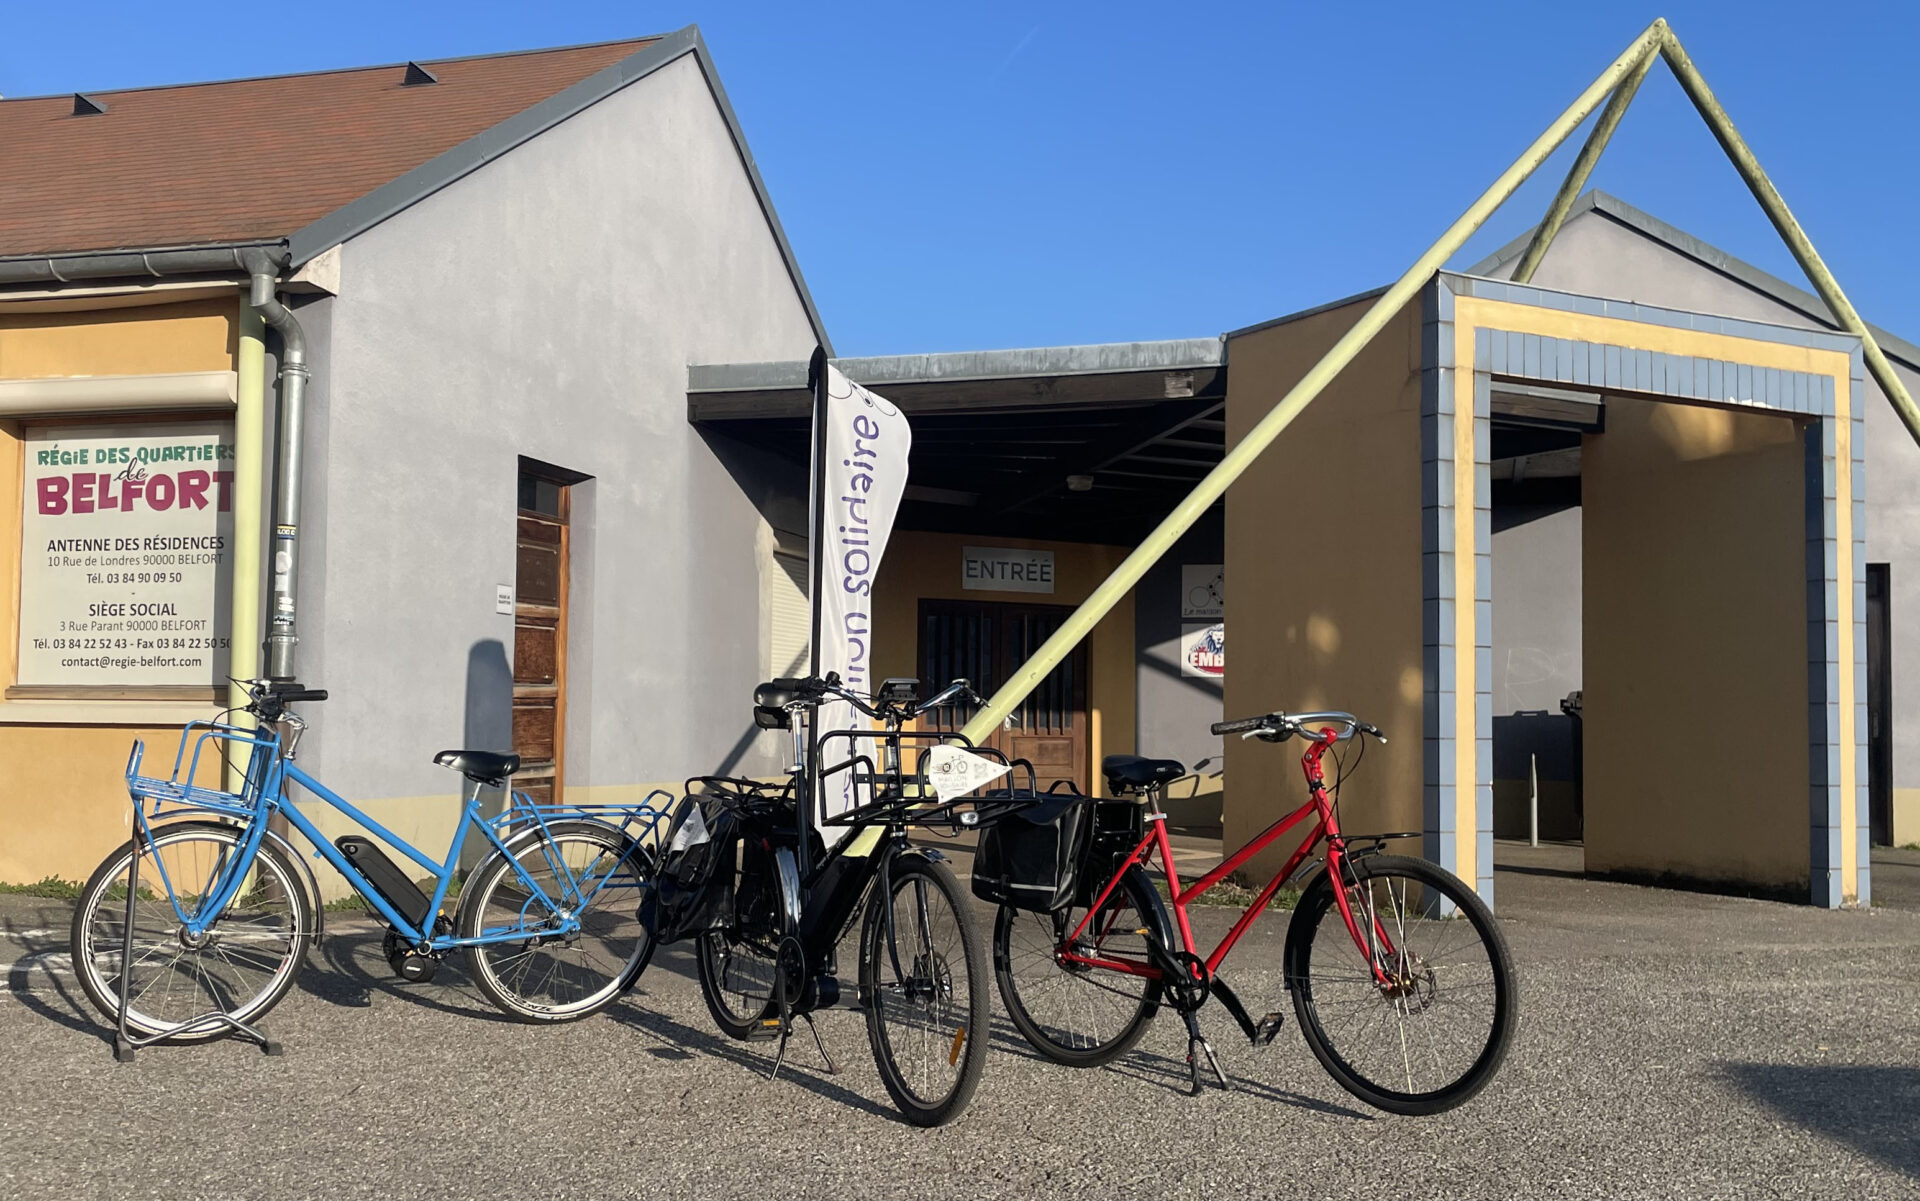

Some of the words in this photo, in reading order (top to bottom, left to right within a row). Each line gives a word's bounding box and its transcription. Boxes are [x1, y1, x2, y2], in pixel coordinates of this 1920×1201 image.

[96, 447, 130, 464] DES
[113, 457, 149, 482] de
[37, 470, 235, 516] BELFORT
[47, 538, 111, 552] ANTENNE
[115, 537, 140, 552] DES
[143, 534, 225, 551] RÉSIDENCES
[48, 556, 60, 567] 10
[63, 556, 82, 567] Rue
[85, 555, 97, 567] de
[100, 554, 140, 567] Londres
[143, 554, 175, 566] 90000
[178, 553, 224, 565] BELFORT
[87, 573, 104, 584] Tél.
[107, 573, 119, 584] 03
[122, 573, 135, 584] 84
[138, 573, 151, 583] 90
[153, 573, 166, 583] 09
[169, 572, 182, 583] 50
[89, 600, 126, 617] SIÈGE
[130, 603, 178, 617] SOCIAL
[60, 621, 66, 631] 3
[69, 620, 88, 631] Rue
[91, 620, 124, 631] Parant
[126, 620, 159, 631] 90000
[161, 619, 207, 631] BELFORT
[33, 638, 50, 649] Tél.
[53, 638, 66, 649] 03
[68, 638, 81, 649] 84
[84, 638, 96, 649] 22
[99, 638, 112, 649] 52
[114, 638, 127, 649] 43
[137, 638, 154, 649] Fax
[156, 638, 170, 649] 03
[172, 638, 185, 649] 84
[188, 638, 201, 649] 22
[204, 638, 217, 649] 50
[61, 655, 202, 669] contact@regie-belfort.com
